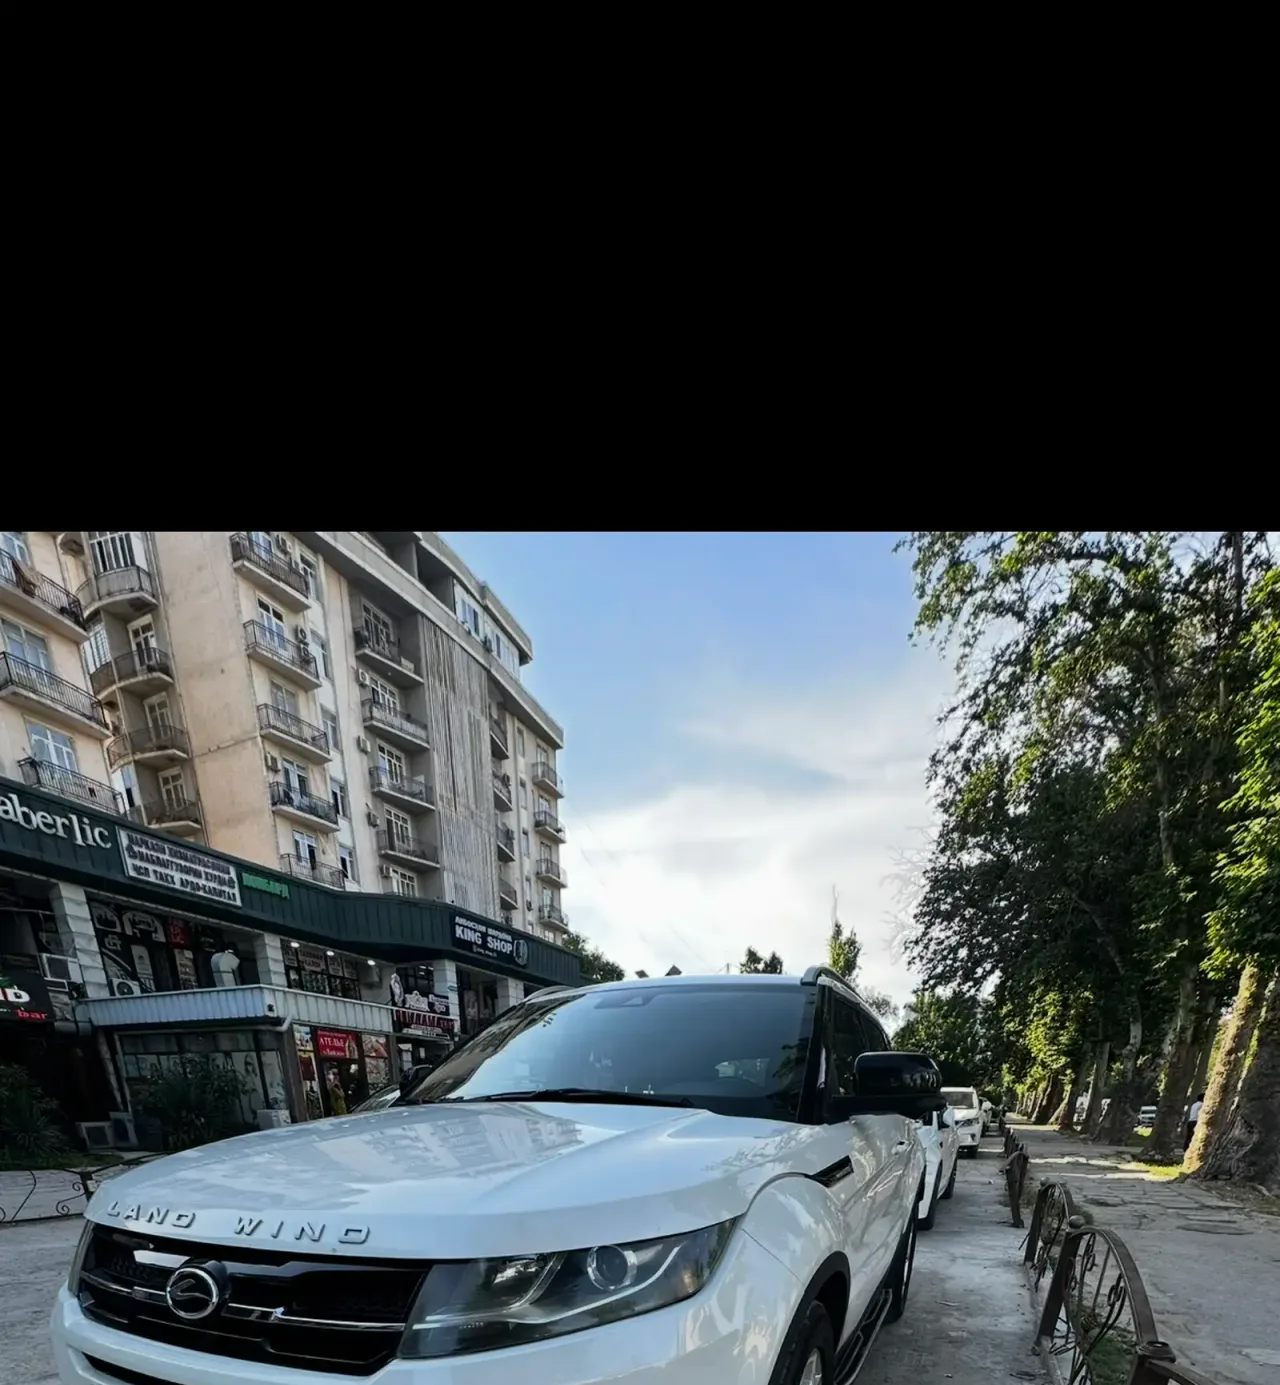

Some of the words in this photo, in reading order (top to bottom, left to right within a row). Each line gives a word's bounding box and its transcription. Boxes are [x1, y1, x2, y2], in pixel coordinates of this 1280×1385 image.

[455, 925, 482, 945] KING
[487, 936, 513, 954] SHOP
[106, 1200, 197, 1229] LAND
[234, 1215, 372, 1245] WIND
